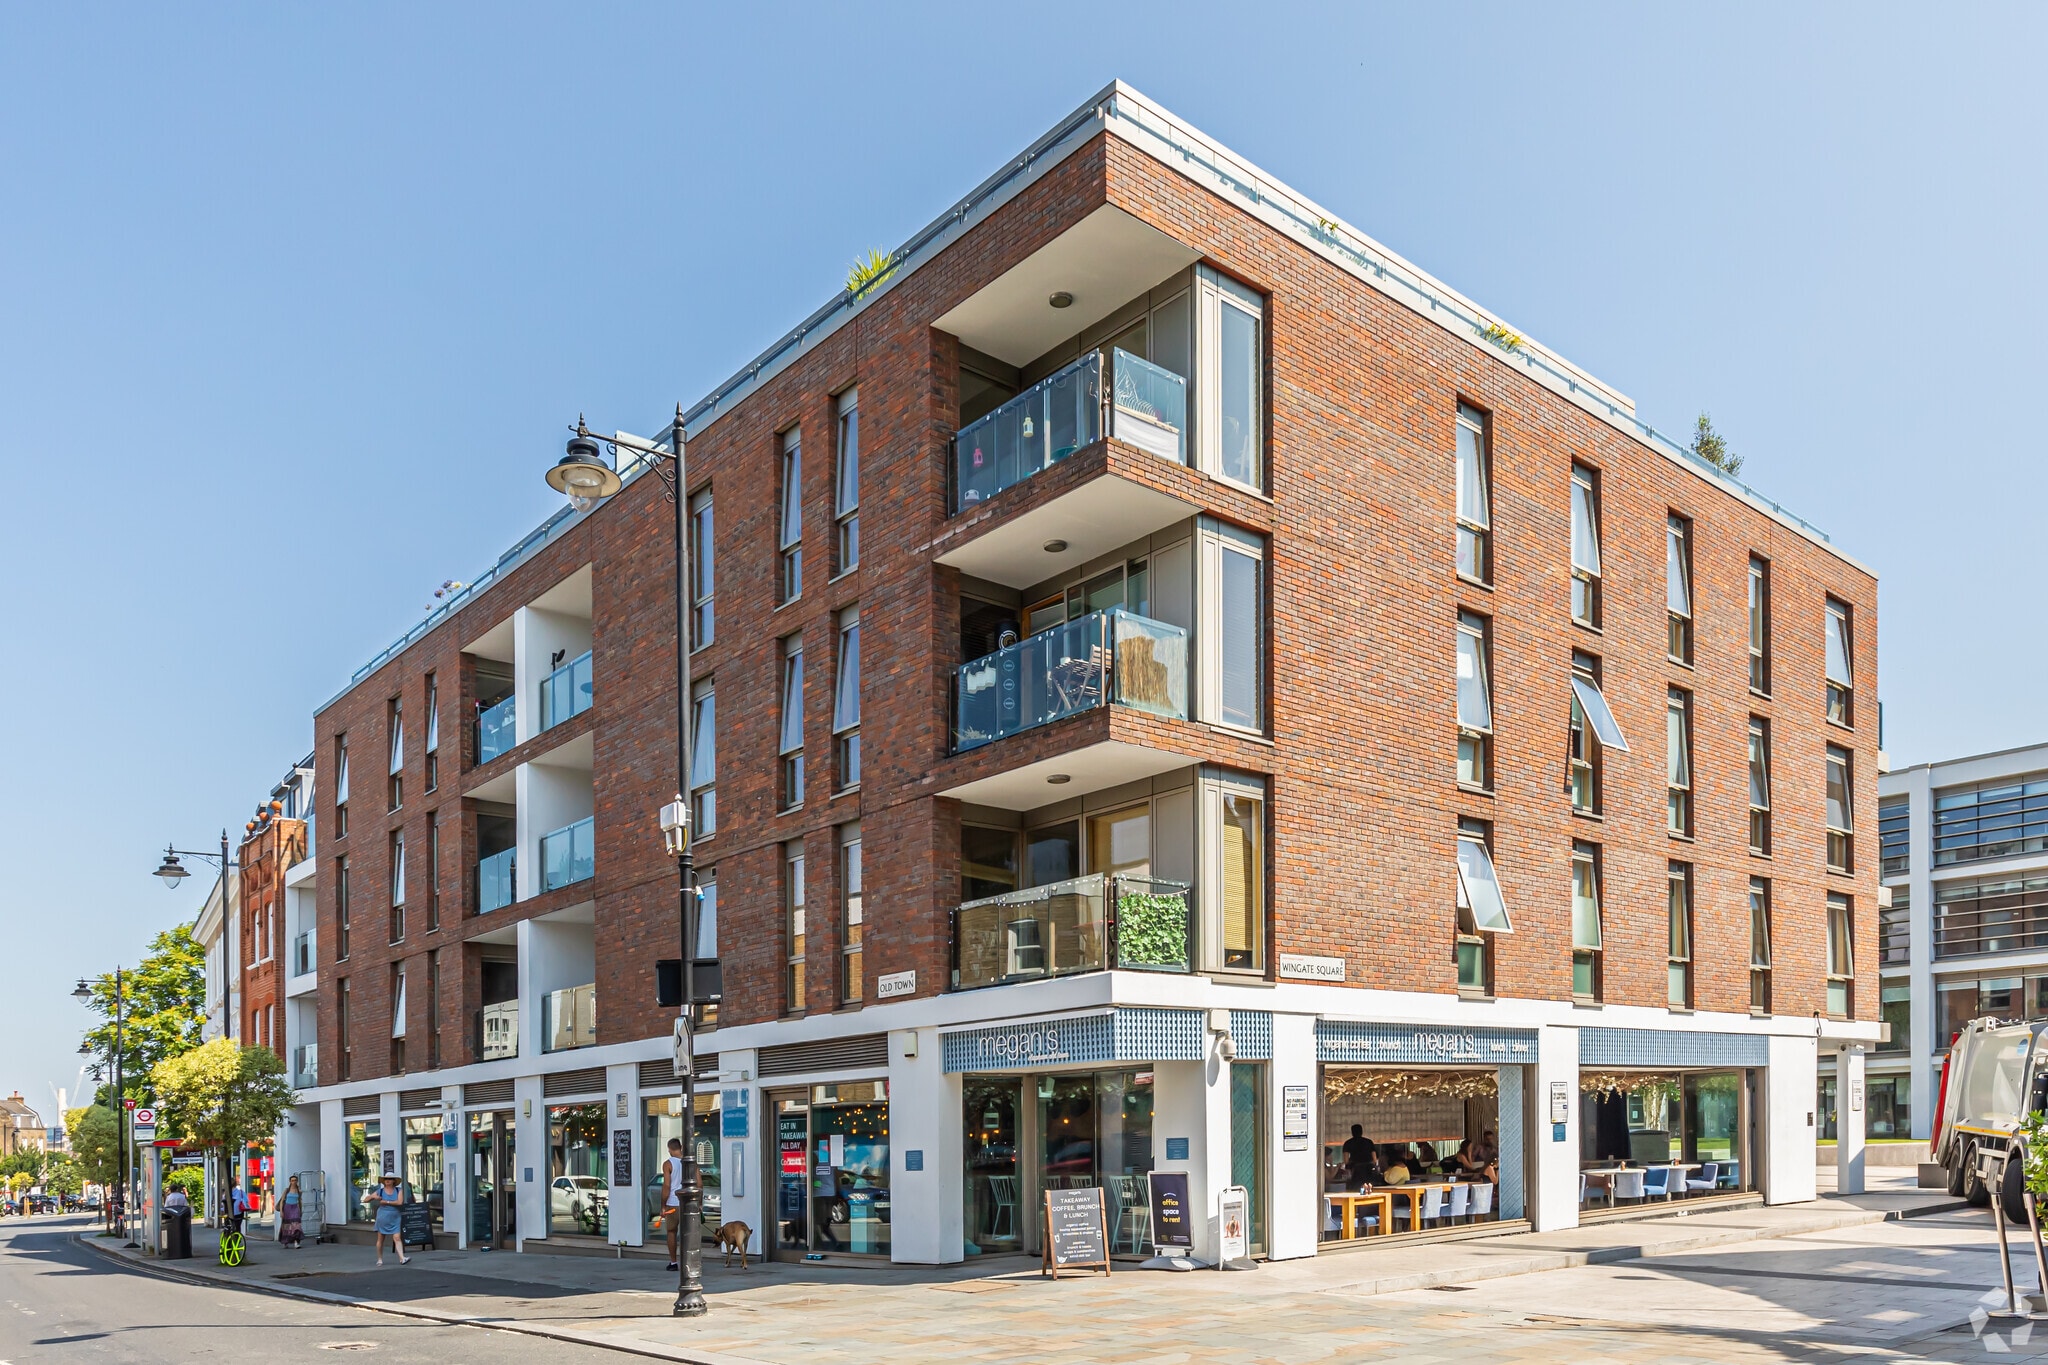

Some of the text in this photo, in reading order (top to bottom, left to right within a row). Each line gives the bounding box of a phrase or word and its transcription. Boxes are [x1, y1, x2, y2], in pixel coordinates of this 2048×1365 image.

[1282, 963, 1343, 976] WINGATE SQUARE
[880, 979, 914, 992] OLD TOWN
[980, 1025, 1058, 1060] megan's
[1414, 1029, 1474, 1056] megan's
[780, 1122, 789, 1130] EAT
